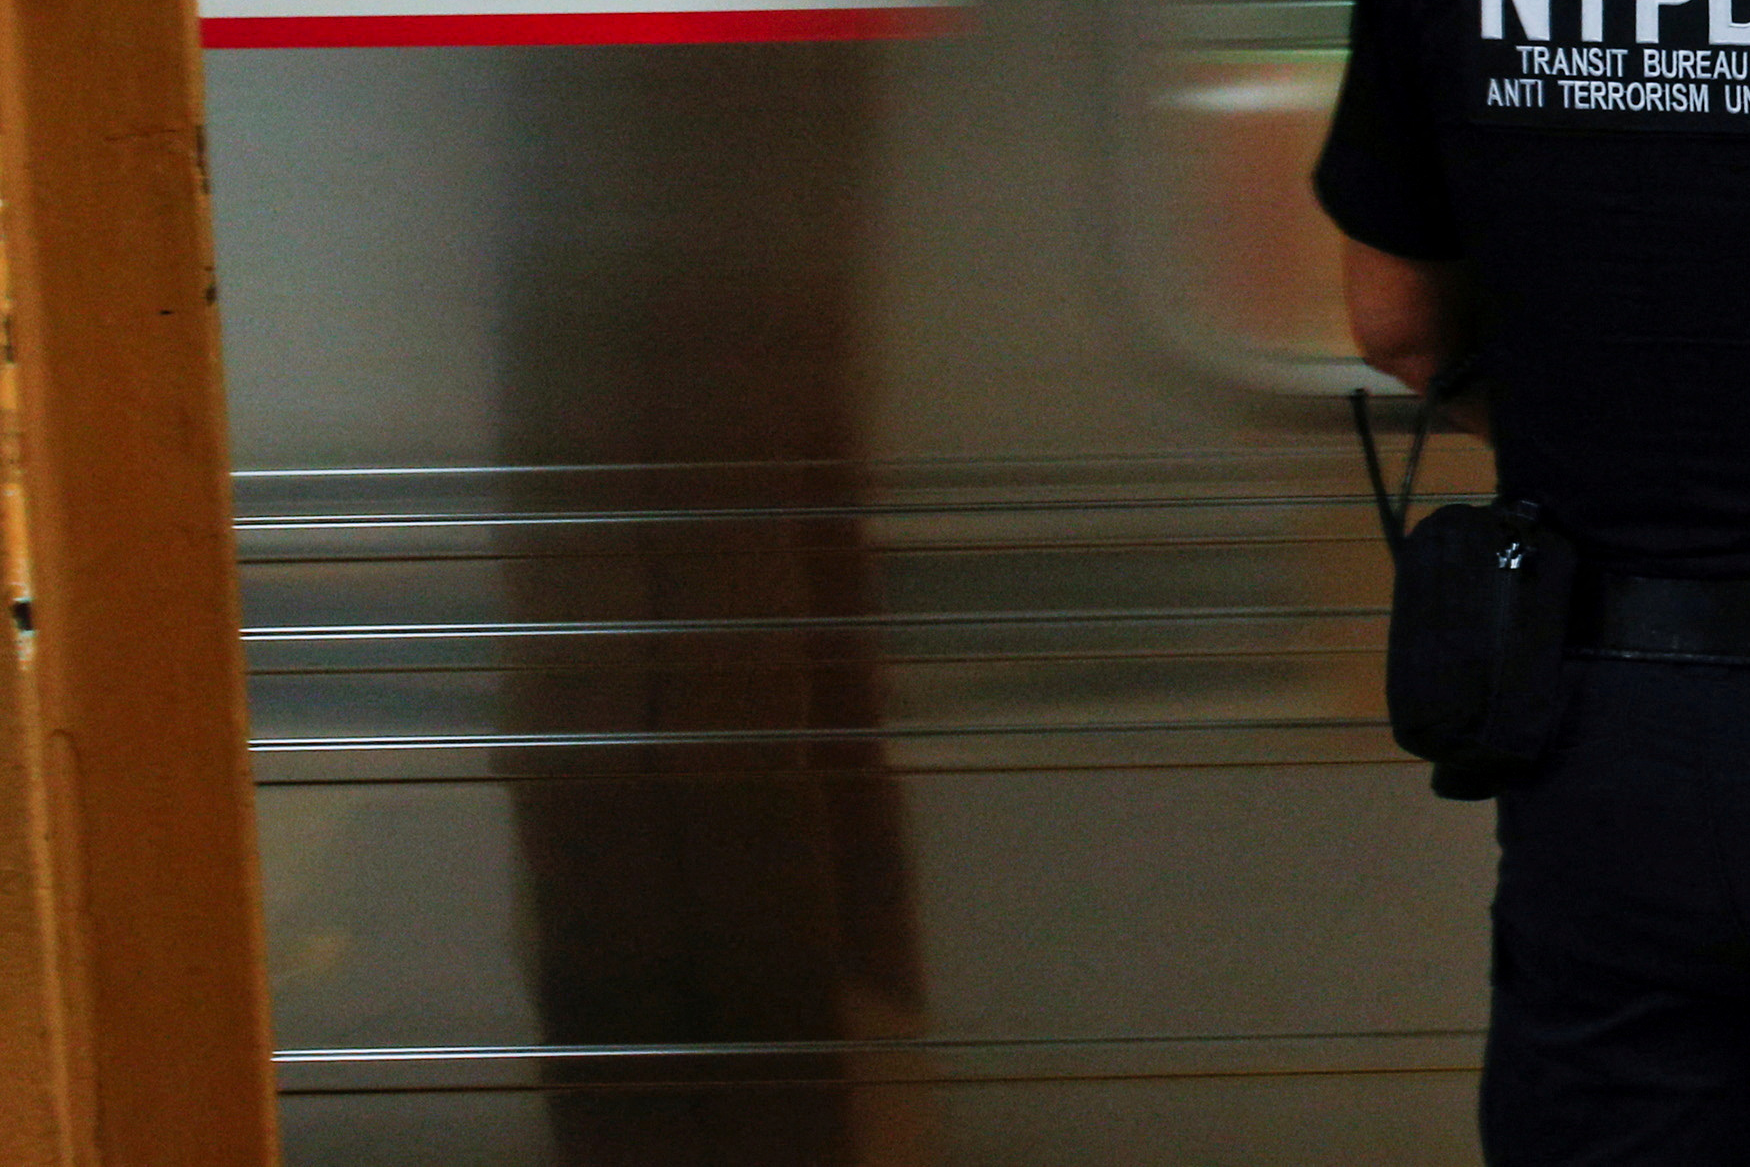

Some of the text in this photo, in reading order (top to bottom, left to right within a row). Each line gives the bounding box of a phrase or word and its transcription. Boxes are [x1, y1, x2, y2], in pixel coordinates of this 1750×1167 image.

[1515, 45, 1749, 81] TRANSIT BUREAU
[1487, 78, 1545, 109] ANTI
[1557, 79, 1710, 113] TERRORISM
